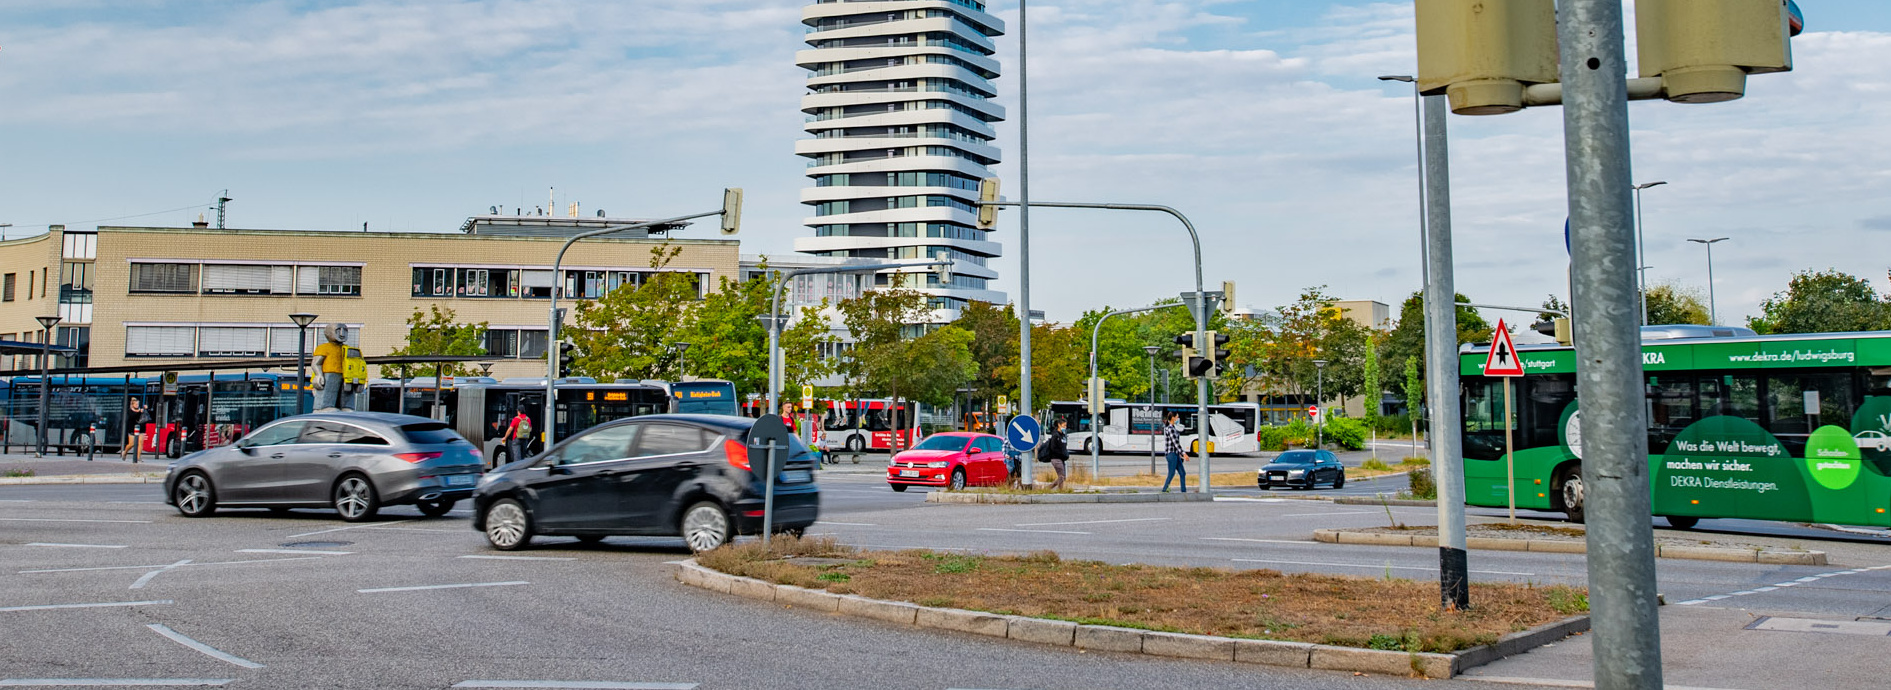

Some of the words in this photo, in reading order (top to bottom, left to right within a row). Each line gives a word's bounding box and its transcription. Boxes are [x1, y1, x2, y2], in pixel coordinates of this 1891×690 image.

[1642, 351, 1666, 365] KRA
[1728, 349, 1854, 363] www.dekra.de/ludwigsburg
[1676, 440, 1698, 452] Was
[1699, 440, 1714, 452] die
[1716, 440, 1740, 453] Welt
[1741, 440, 1781, 457] bewegt,
[1666, 458, 1703, 470] machen
[1704, 460, 1720, 470] wir
[1722, 459, 1753, 471] sicher.
[1670, 476, 1703, 488] DEKRA
[1704, 477, 1779, 494] Dienstleistungen.
